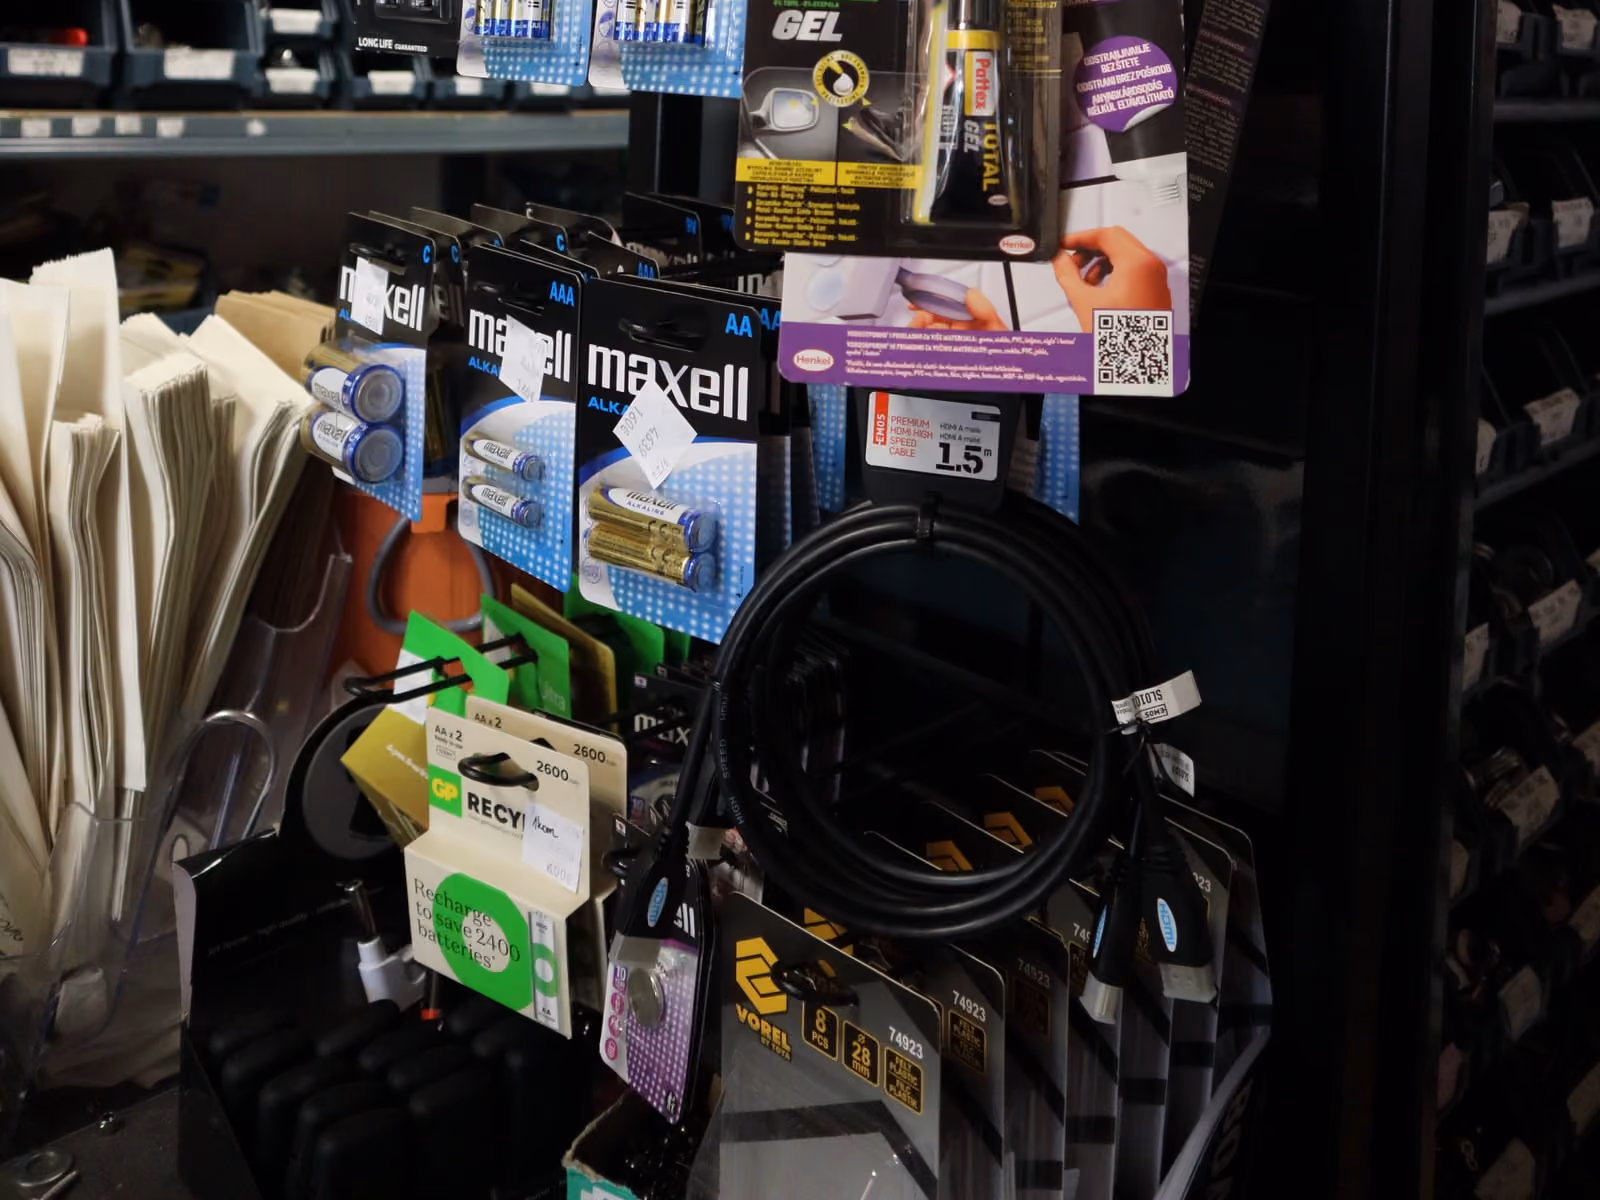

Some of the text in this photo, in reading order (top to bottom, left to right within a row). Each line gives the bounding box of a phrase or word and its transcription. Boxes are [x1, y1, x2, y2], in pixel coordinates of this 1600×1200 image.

[772, 9, 843, 42] GEL
[358, 37, 378, 49] LONG
[379, 39, 393, 50] LIFE
[975, 58, 991, 109] Pattex
[964, 119, 979, 153] GEL
[983, 122, 1000, 192] TOTAL
[423, 245, 431, 264] C
[1002, 240, 1033, 249] Henkel
[550, 281, 575, 307] AAA
[725, 313, 752, 338] AA
[795, 353, 832, 366] Henkel
[588, 344, 748, 421] maxell
[890, 416, 930, 429] PREMIUM
[890, 426, 933, 440] HDMI HIGH
[483, 441, 511, 460] maxell
[889, 437, 917, 447] SPEED
[889, 447, 916, 458] CABLE
[481, 487, 509, 507] maxell
[474, 713, 487, 725] AA
[495, 717, 502, 729] 2
[434, 725, 447, 737] AA
[456, 730, 463, 742] 2
[573, 743, 606, 764] 2600
[536, 760, 569, 782] 2600
[431, 777, 458, 801] GP
[467, 791, 525, 832] RECY
[413, 878, 492, 928] Recharge
[416, 901, 520, 962] to save 2400
[952, 990, 987, 1022] 74923
[735, 1003, 792, 1052] VOREL
[815, 1008, 827, 1034] 8
[811, 1030, 829, 1049] PCS
[888, 1026, 924, 1059] 74923
[851, 1041, 871, 1067] 28
[852, 1060, 870, 1078] mm
